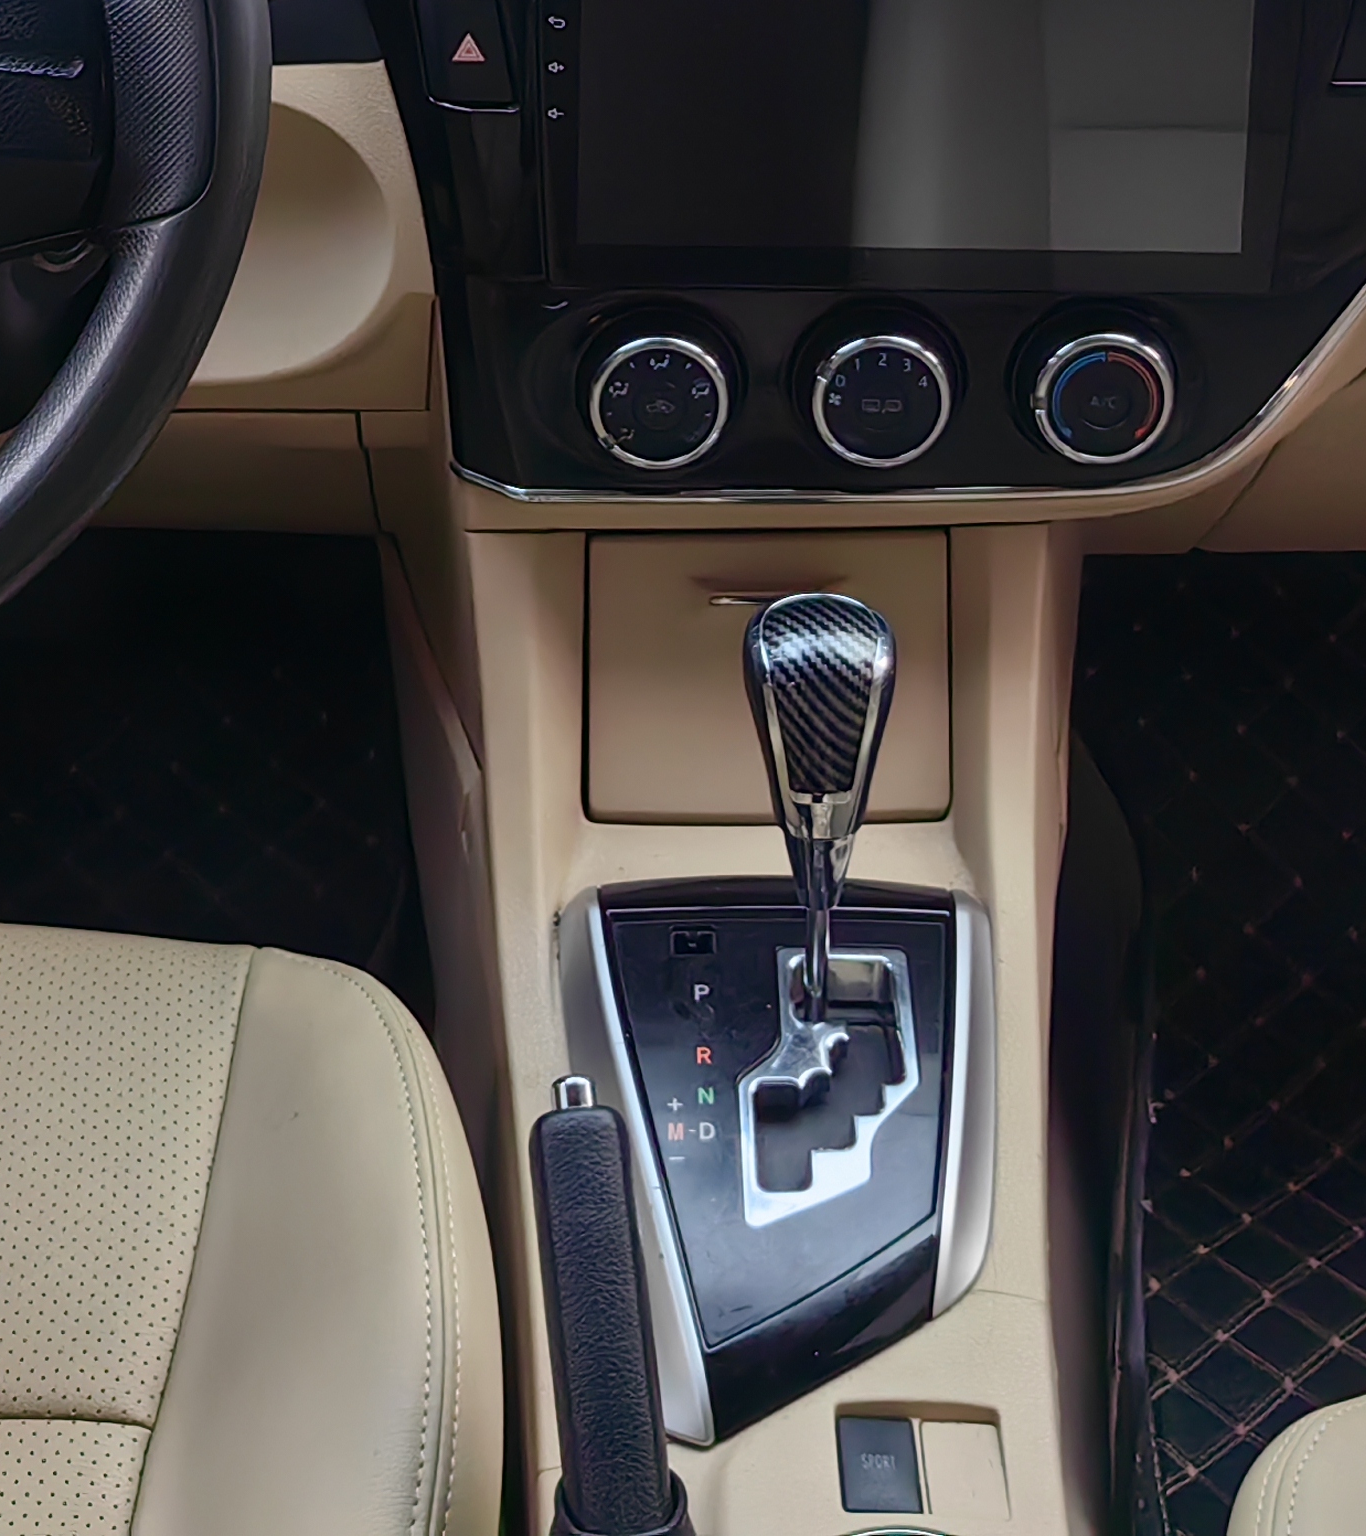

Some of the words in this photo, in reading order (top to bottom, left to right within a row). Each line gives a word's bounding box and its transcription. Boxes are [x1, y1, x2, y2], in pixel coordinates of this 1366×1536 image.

[878, 352, 888, 367] 2
[902, 358, 912, 372] 3
[918, 375, 928, 388] 4
[693, 984, 710, 1001] P
[696, 1047, 713, 1065] R
[697, 1087, 714, 1105] N
[860, 1453, 897, 1470] SPORT
